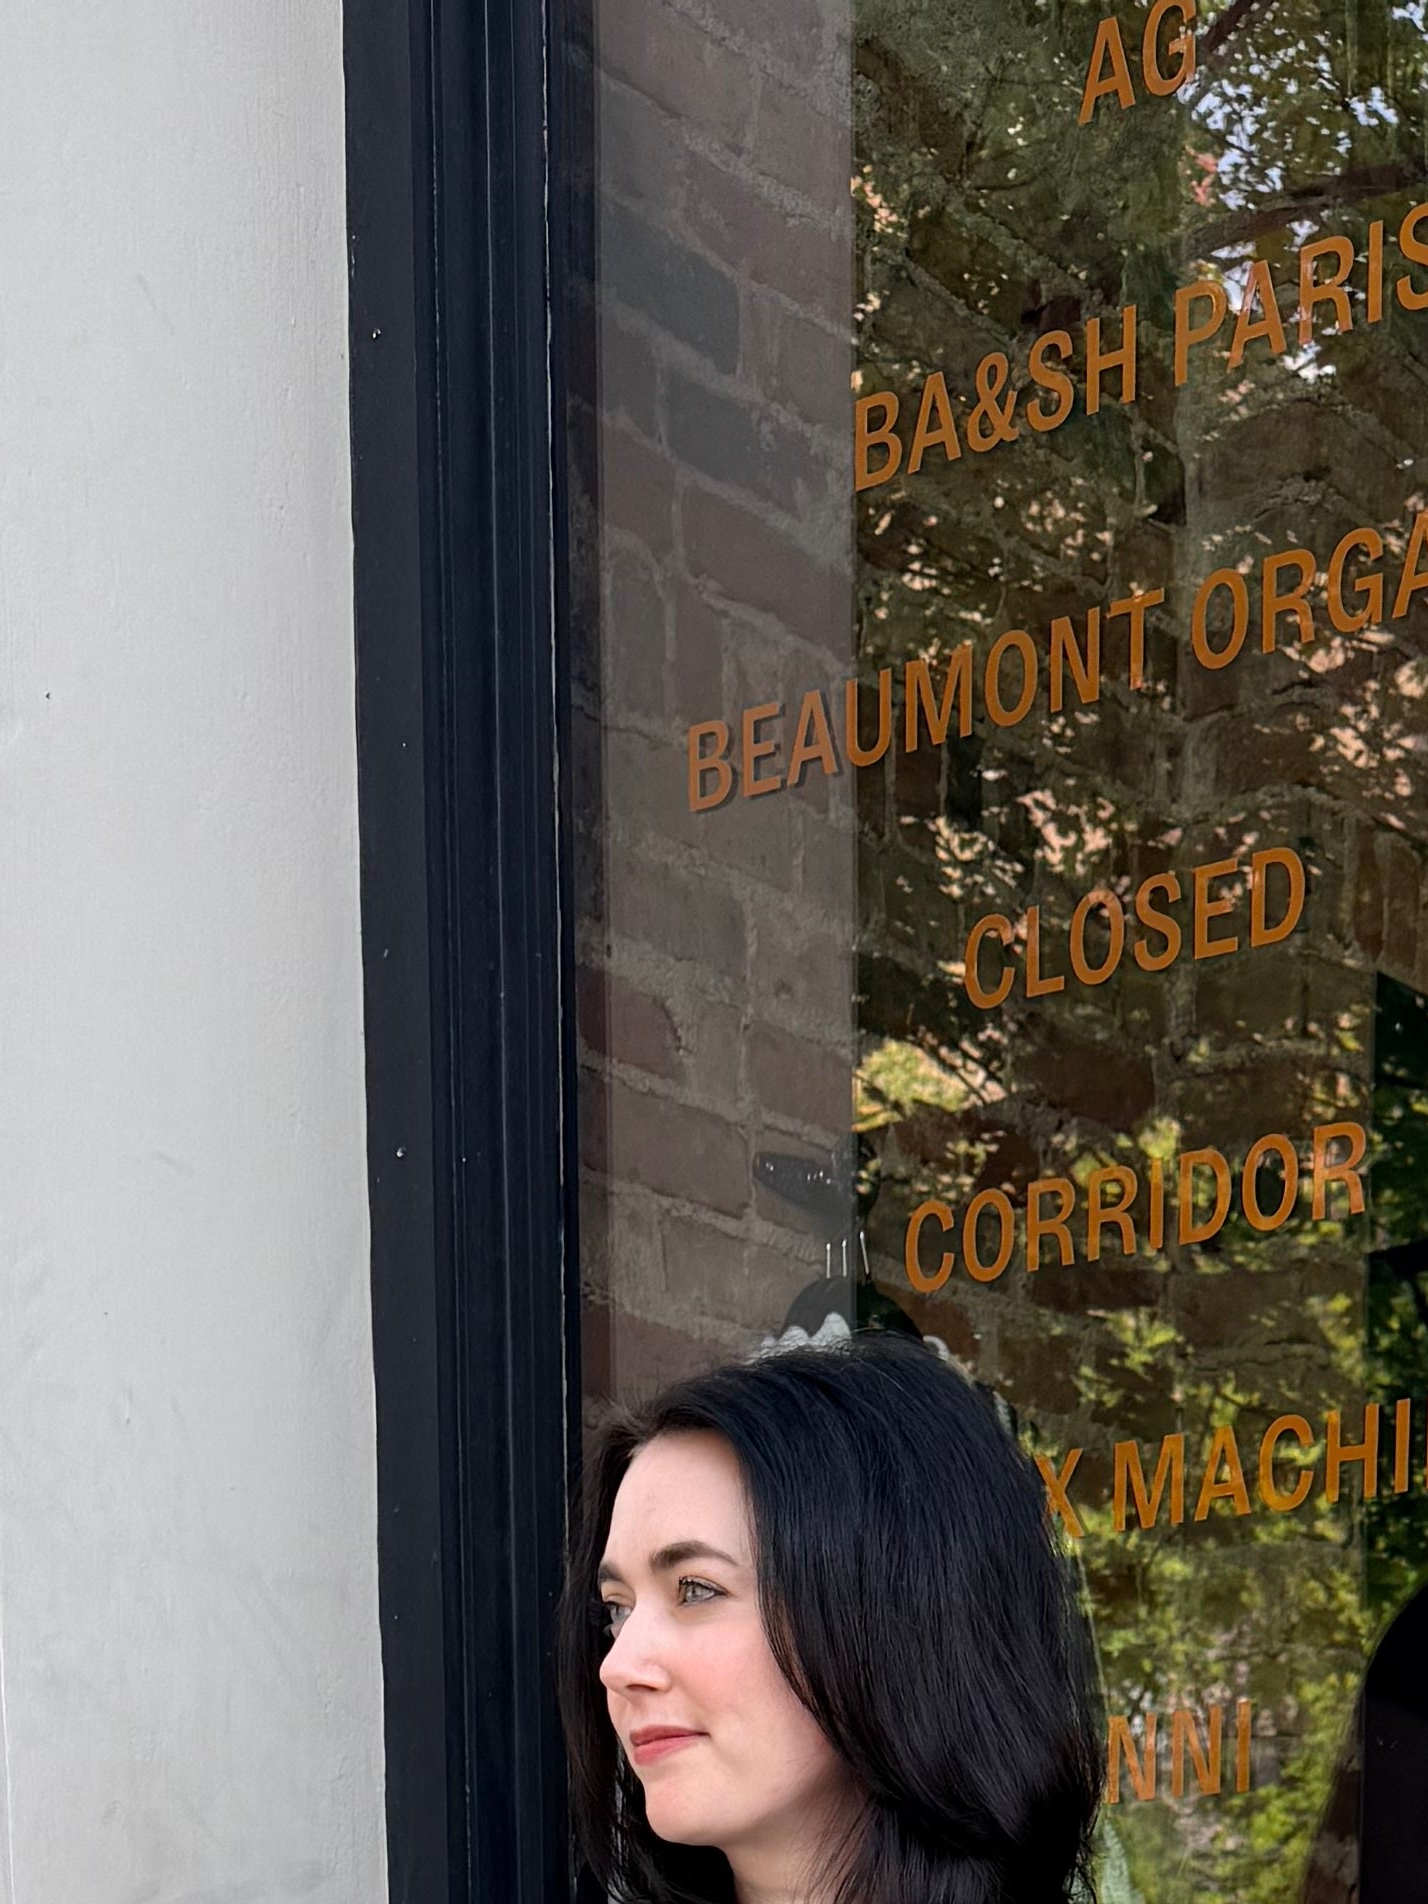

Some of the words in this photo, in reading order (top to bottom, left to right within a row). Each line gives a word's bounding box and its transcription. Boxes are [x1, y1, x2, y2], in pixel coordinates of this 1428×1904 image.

[1078, 0, 1197, 126] AG
[853, 304, 1137, 492] BA&SH
[686, 585, 1165, 813] BEAUMONT
[964, 846, 1306, 1009] CLOSED
[905, 1121, 1367, 1295] CORRIDOR
[1106, 1698, 1253, 1805] NNI
